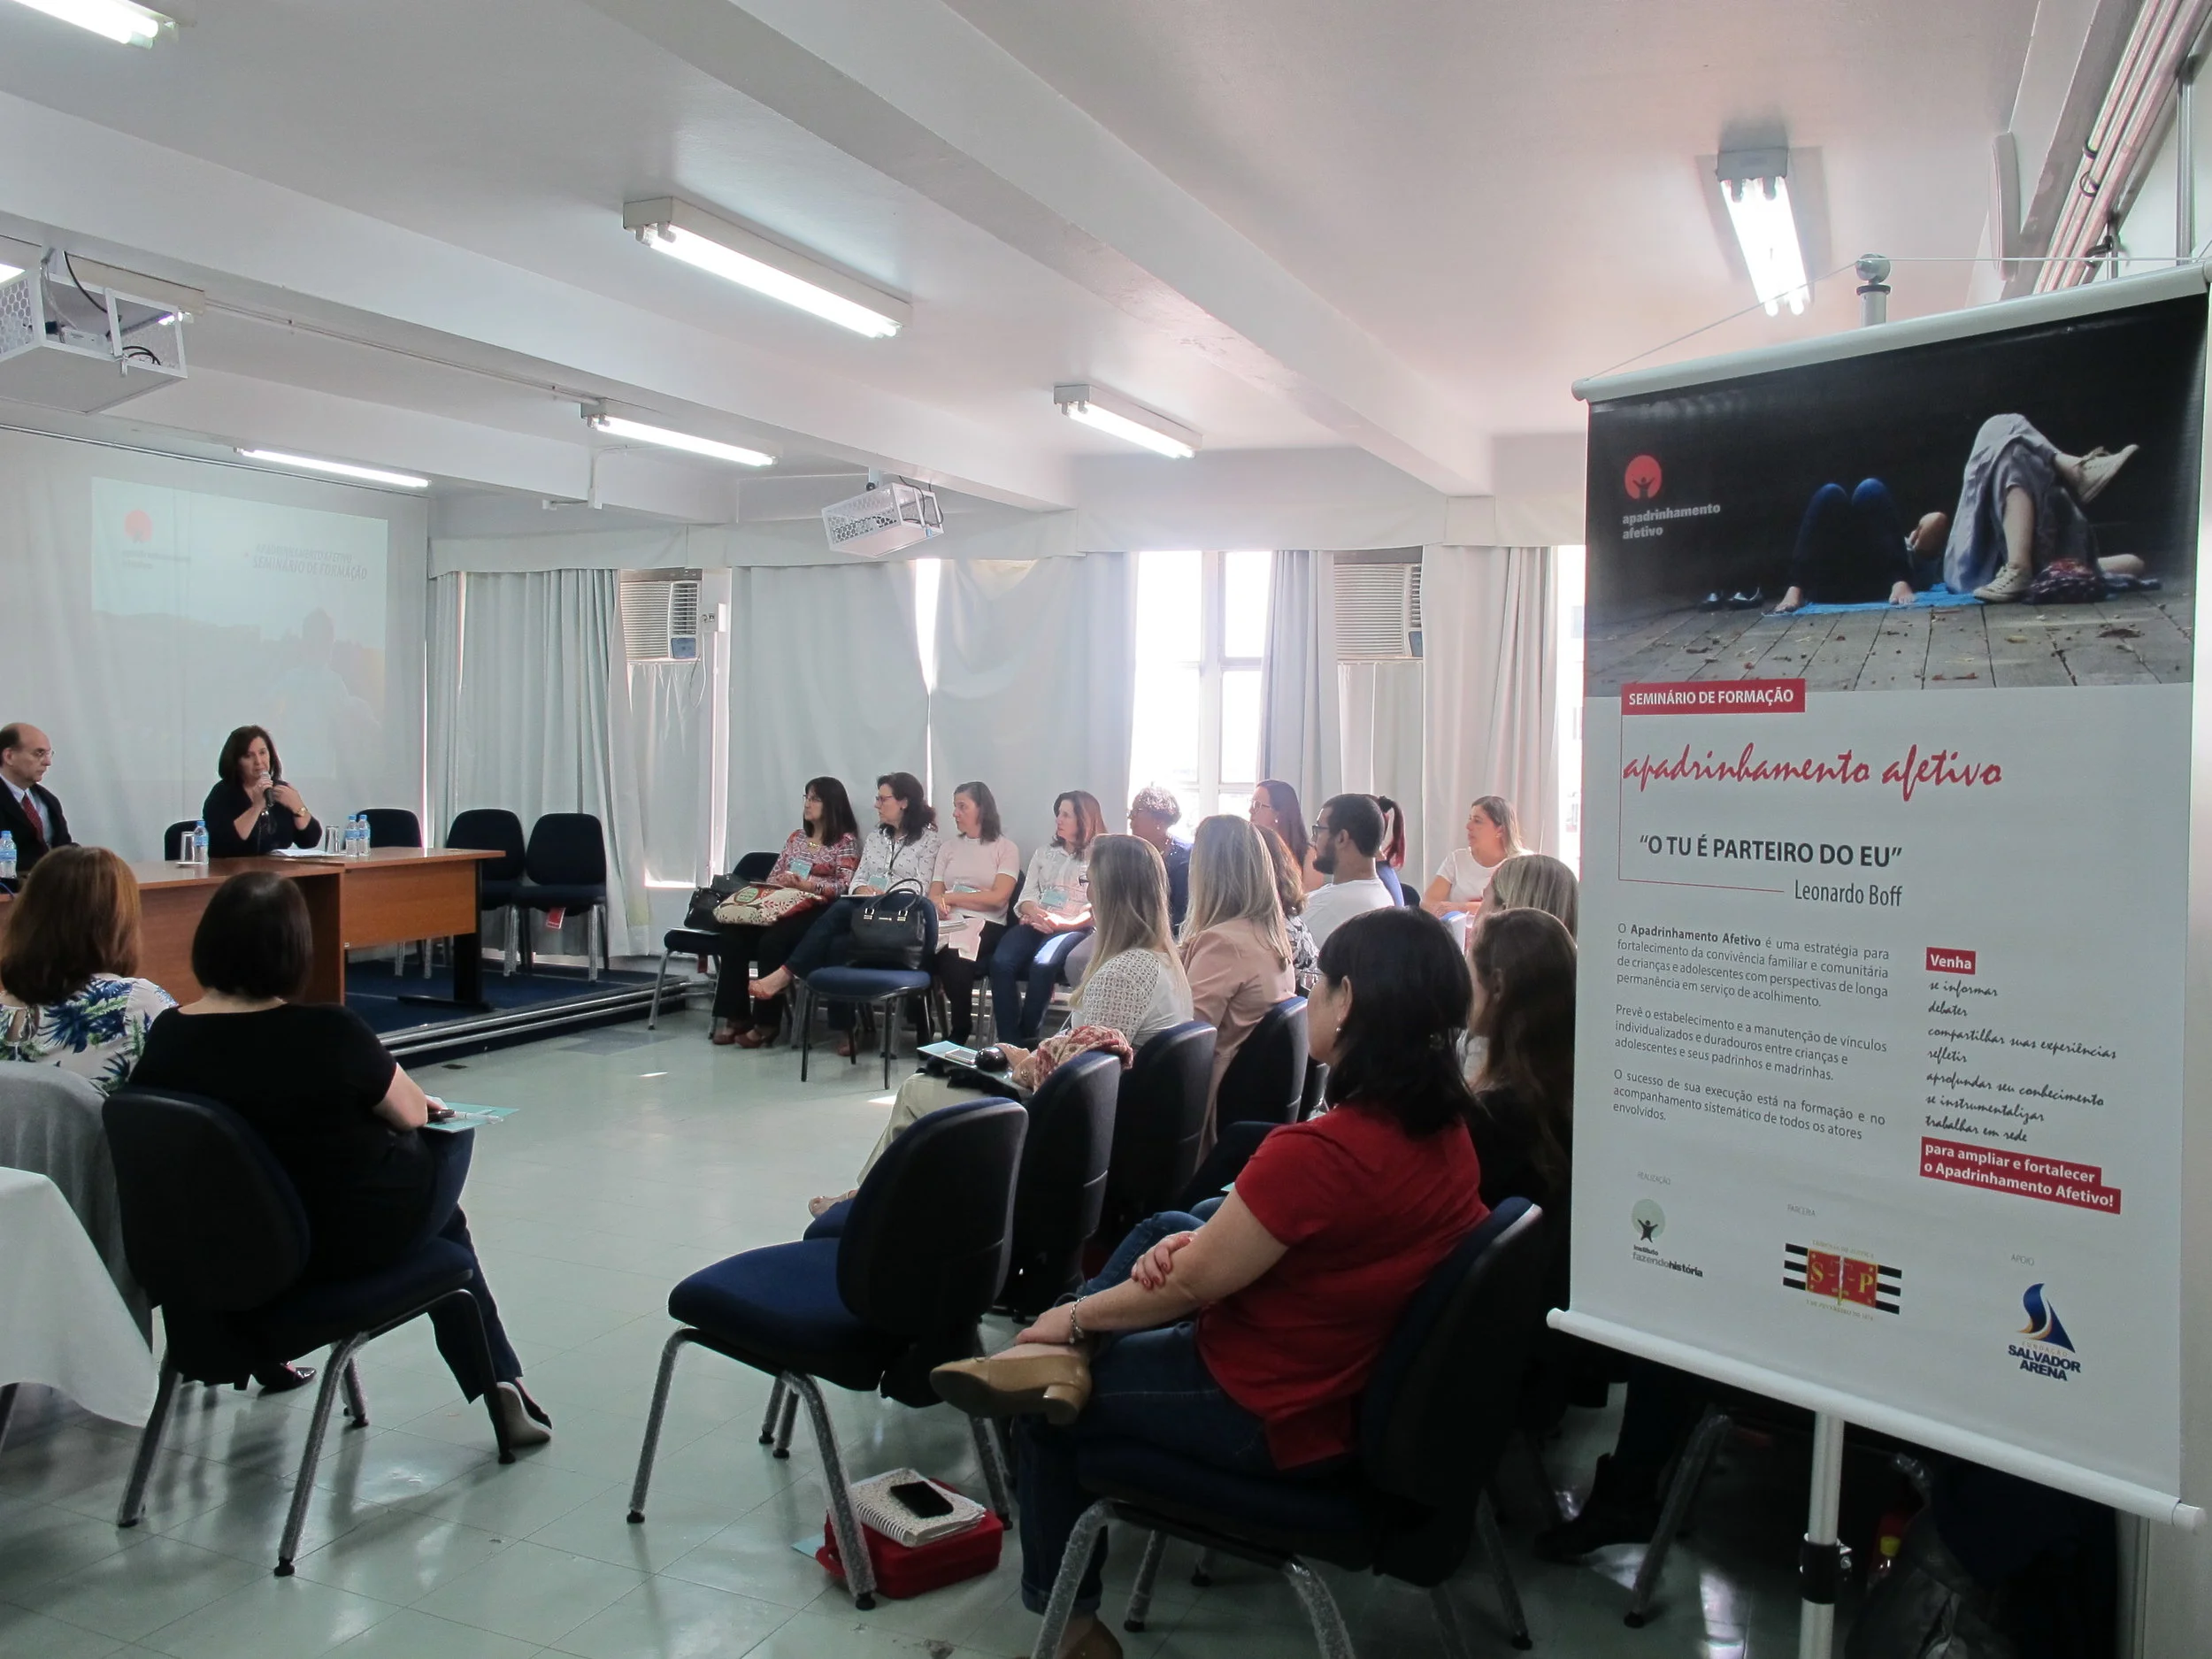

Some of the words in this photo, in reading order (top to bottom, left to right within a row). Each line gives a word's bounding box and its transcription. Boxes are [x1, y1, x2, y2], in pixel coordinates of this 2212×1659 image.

[1623, 503, 1721, 526] apadrinhamento
[1623, 526, 1663, 540] afetivo
[1629, 689, 1696, 705] SEMINÁRIO
[1699, 691, 1715, 704] DE
[1718, 687, 1794, 706] FORMAÇÃO
[1623, 742, 1870, 792] apadrinhamento
[1881, 743, 2001, 802] afetivo
[1640, 834, 1663, 854] “O
[1666, 836, 1692, 856] TU
[1697, 834, 1708, 856] É
[1713, 840, 1814, 864] PARTEIRO
[1819, 843, 1854, 865] DO
[1860, 846, 1902, 867] EU”
[1795, 879, 1864, 904] Leonardo
[1869, 884, 1902, 906] Boff
[1631, 924, 1718, 942] Apadrinhamento
[1722, 932, 1761, 948] Afetivo
[1777, 941, 1800, 951] uma
[1804, 941, 1858, 959] estratégia
[1863, 949, 1889, 961] para
[1617, 939, 1689, 956] fortalecimento
[1691, 946, 1703, 958] da
[1706, 949, 1764, 965] convivência
[1768, 954, 1807, 970] familiar
[1820, 959, 1888, 979] comunitária
[1930, 954, 1972, 970] Venha
[1617, 956, 1630, 967] de
[1632, 957, 1671, 972] crianças
[1680, 962, 1744, 980] adolescentes
[1745, 972, 1768, 982] com
[1770, 973, 1836, 992] perspectivas
[1839, 980, 1853, 993] de
[1855, 980, 1888, 999] longa
[1617, 972, 1679, 989] permanência
[1682, 981, 1698, 992] em
[1700, 981, 1735, 998] serviço
[1738, 985, 1750, 998] de
[1753, 987, 1822, 1008] acolhimento.
[1929, 981, 1939, 990] se
[1944, 979, 1998, 998] informar
[1928, 1001, 1968, 1017] debater
[1616, 1003, 1643, 1018] Prevê
[1653, 1009, 1734, 1031] estabelecimento
[1754, 1024, 1820, 1044] manutenção
[1824, 1032, 1838, 1045] de
[1840, 1035, 1887, 1053] vínculos
[1616, 1021, 1694, 1041] individualizados
[1704, 1033, 1763, 1051] duradouros
[1765, 1043, 1793, 1056] entre
[1794, 1048, 1839, 1066] crianças
[1928, 1028, 2005, 1045] compartilhar
[2009, 1038, 2037, 1048] suas
[2040, 1040, 2116, 1059] experiências
[1615, 1037, 1678, 1056] adolescentes
[1687, 1049, 1709, 1061] seus
[1712, 1052, 1763, 1070] padrinhos
[1774, 1061, 1834, 1081] madrinhas.
[1927, 1048, 1967, 1064] refletir
[1626, 1071, 1663, 1087] sucesso
[1667, 1078, 1680, 1089] de
[1684, 1082, 1701, 1093] sua
[1705, 1085, 1752, 1102] execução
[1757, 1094, 1778, 1107] está
[1784, 1099, 1796, 1110] na
[1801, 1100, 1853, 1120] formação
[1870, 1114, 1886, 1126] no
[1927, 1071, 1991, 1089] aprofundar
[1996, 1082, 2015, 1093] seu
[2019, 1084, 2104, 1106] conhecimento
[1613, 1103, 1666, 1120] envolvidos.
[1614, 1086, 1701, 1110] acompanhamento
[1704, 1102, 1761, 1122] sistemático
[1764, 1111, 1777, 1124] de
[1779, 1116, 1809, 1130] todos
[1812, 1122, 1825, 1133] os
[1828, 1125, 1863, 1140] atores
[1925, 1095, 1936, 1104] se
[1939, 1096, 2045, 1125] instrumentalizar
[1925, 1116, 1979, 1134] trabalhar
[2003, 1128, 2027, 1142] rede
[1925, 1143, 1955, 1157] para
[1958, 1148, 2010, 1168] ampliar
[2024, 1159, 2095, 1183] fortalecer
[1936, 1162, 2052, 1195] Apadrinhamento
[2055, 1185, 2114, 1207] Afetivo!
[2011, 1254, 2034, 1266] APOIO
[1811, 1263, 1824, 1282] S
[1859, 1272, 1873, 1294] P
[2008, 1344, 2081, 1373] SALVADOR
[2020, 1360, 2068, 1381] ARENA
